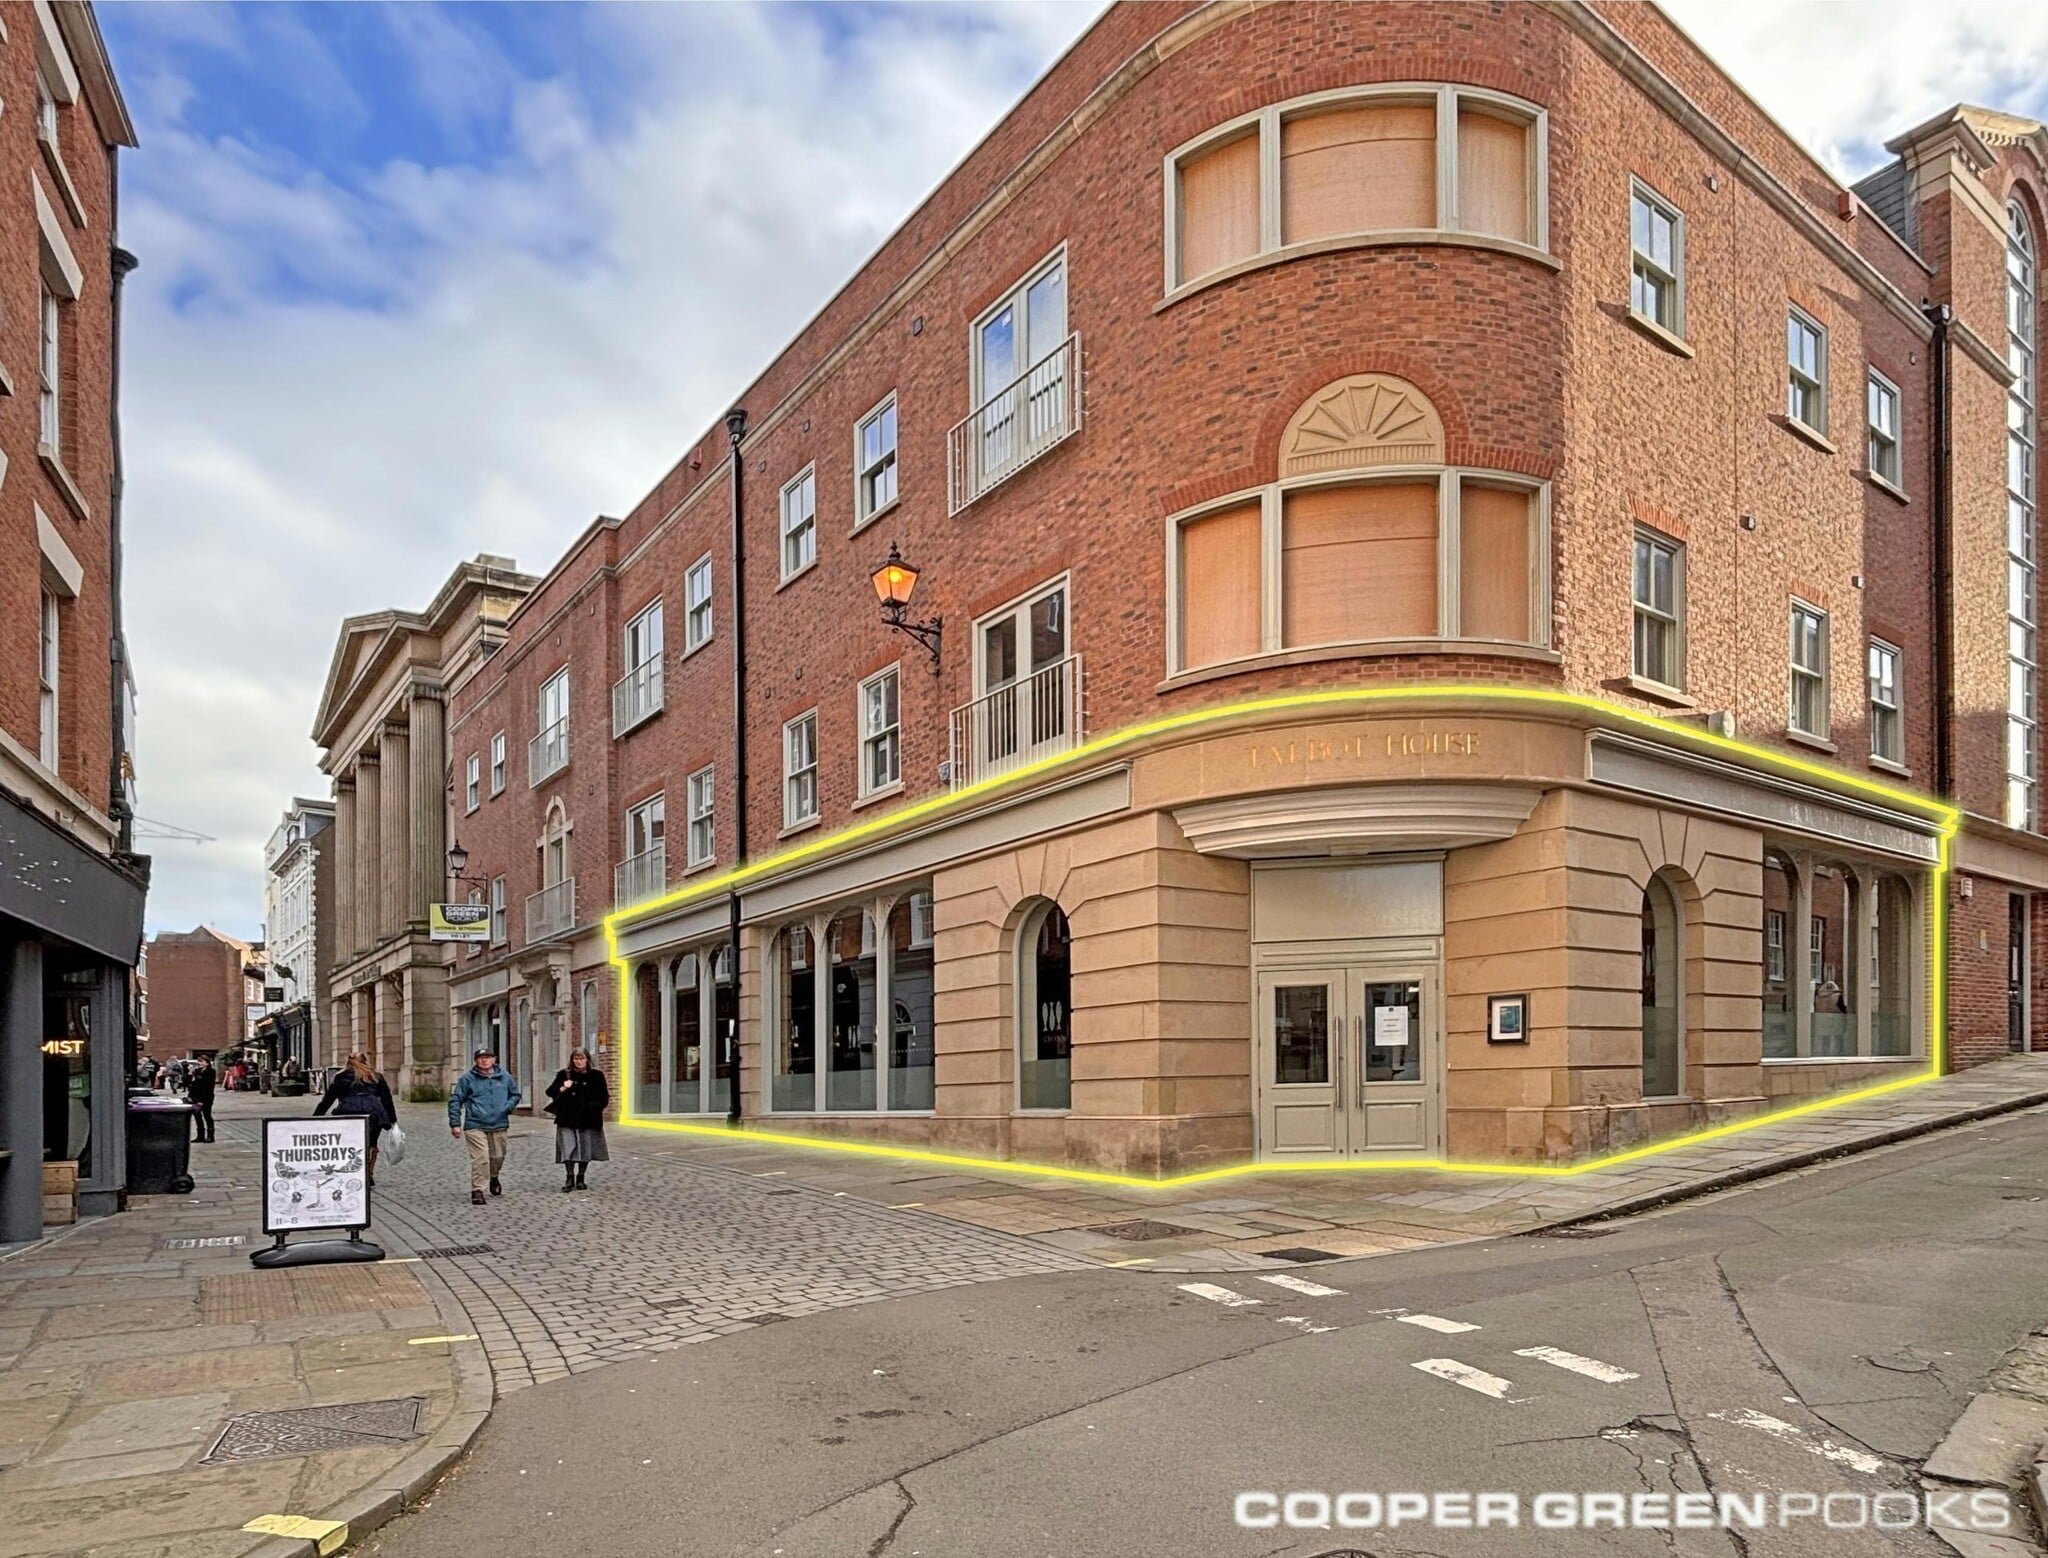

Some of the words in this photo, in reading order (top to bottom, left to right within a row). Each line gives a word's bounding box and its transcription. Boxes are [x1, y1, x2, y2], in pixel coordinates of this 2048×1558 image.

[1386, 732, 1481, 757] HOUSE
[292, 1133, 342, 1147] THIRSTY
[277, 1147, 356, 1163] THURSDAYS
